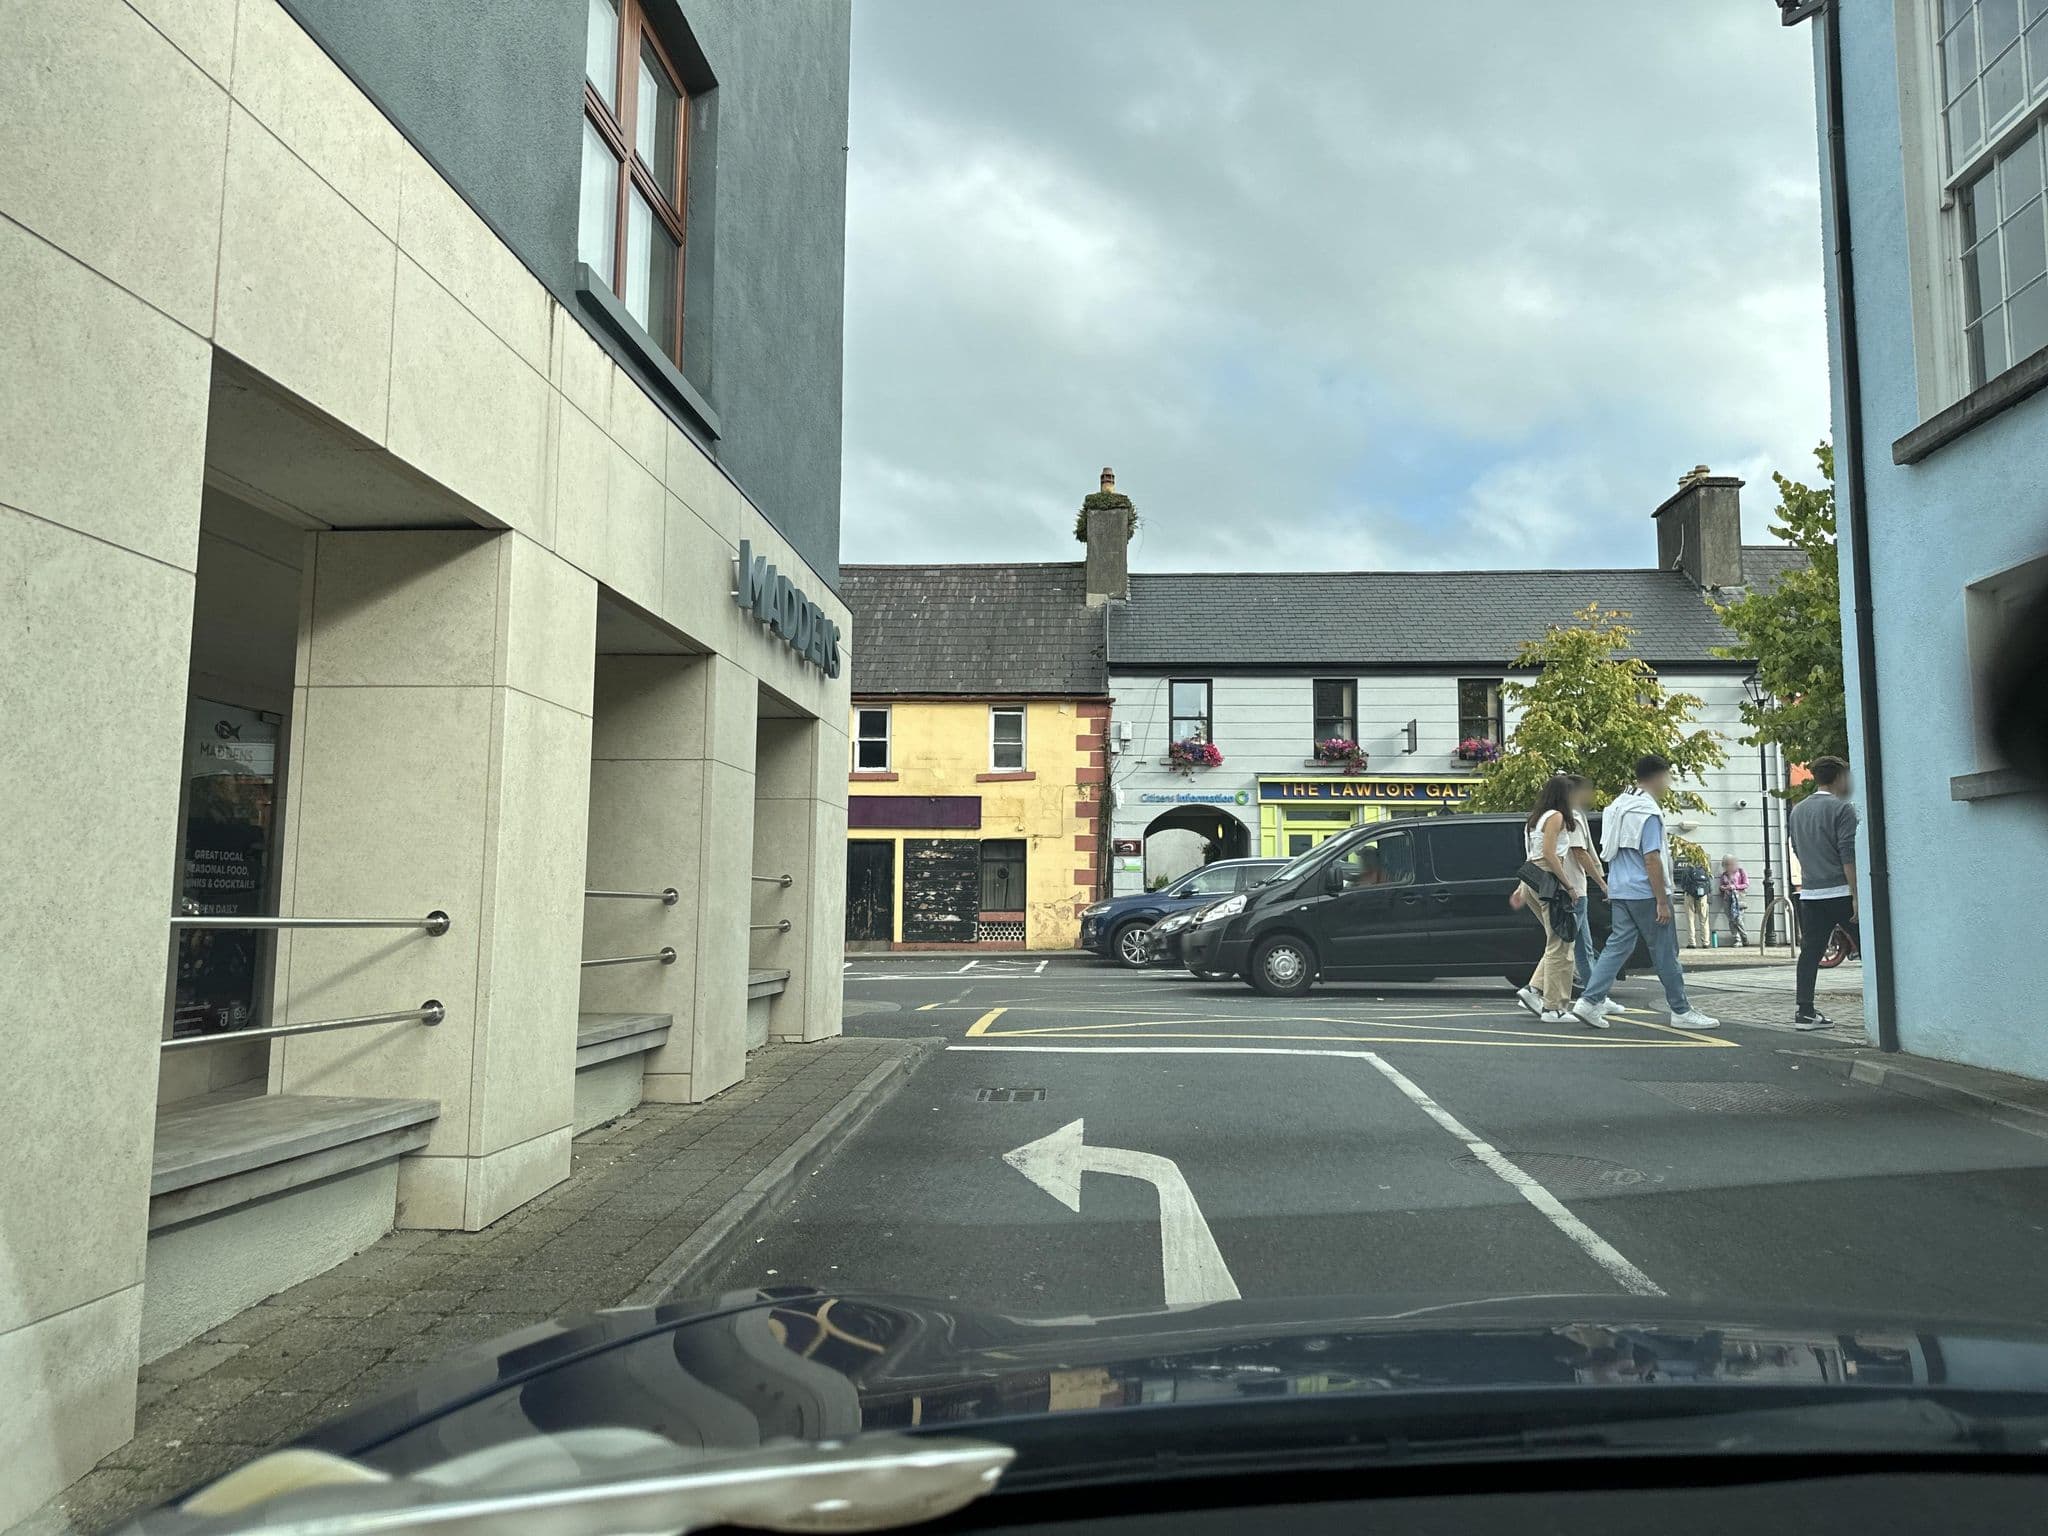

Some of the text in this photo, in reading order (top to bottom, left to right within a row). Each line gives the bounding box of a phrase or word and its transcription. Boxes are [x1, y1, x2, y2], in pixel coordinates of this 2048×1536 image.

[739, 539, 841, 679] MADDENS
[1281, 783, 1320, 796] THE
[1330, 783, 1415, 797] LAWLOR
[1140, 793, 1174, 803] Citizens
[195, 849, 244, 862] GREAT LOCAL
[214, 879, 255, 889] COCKTAILS
